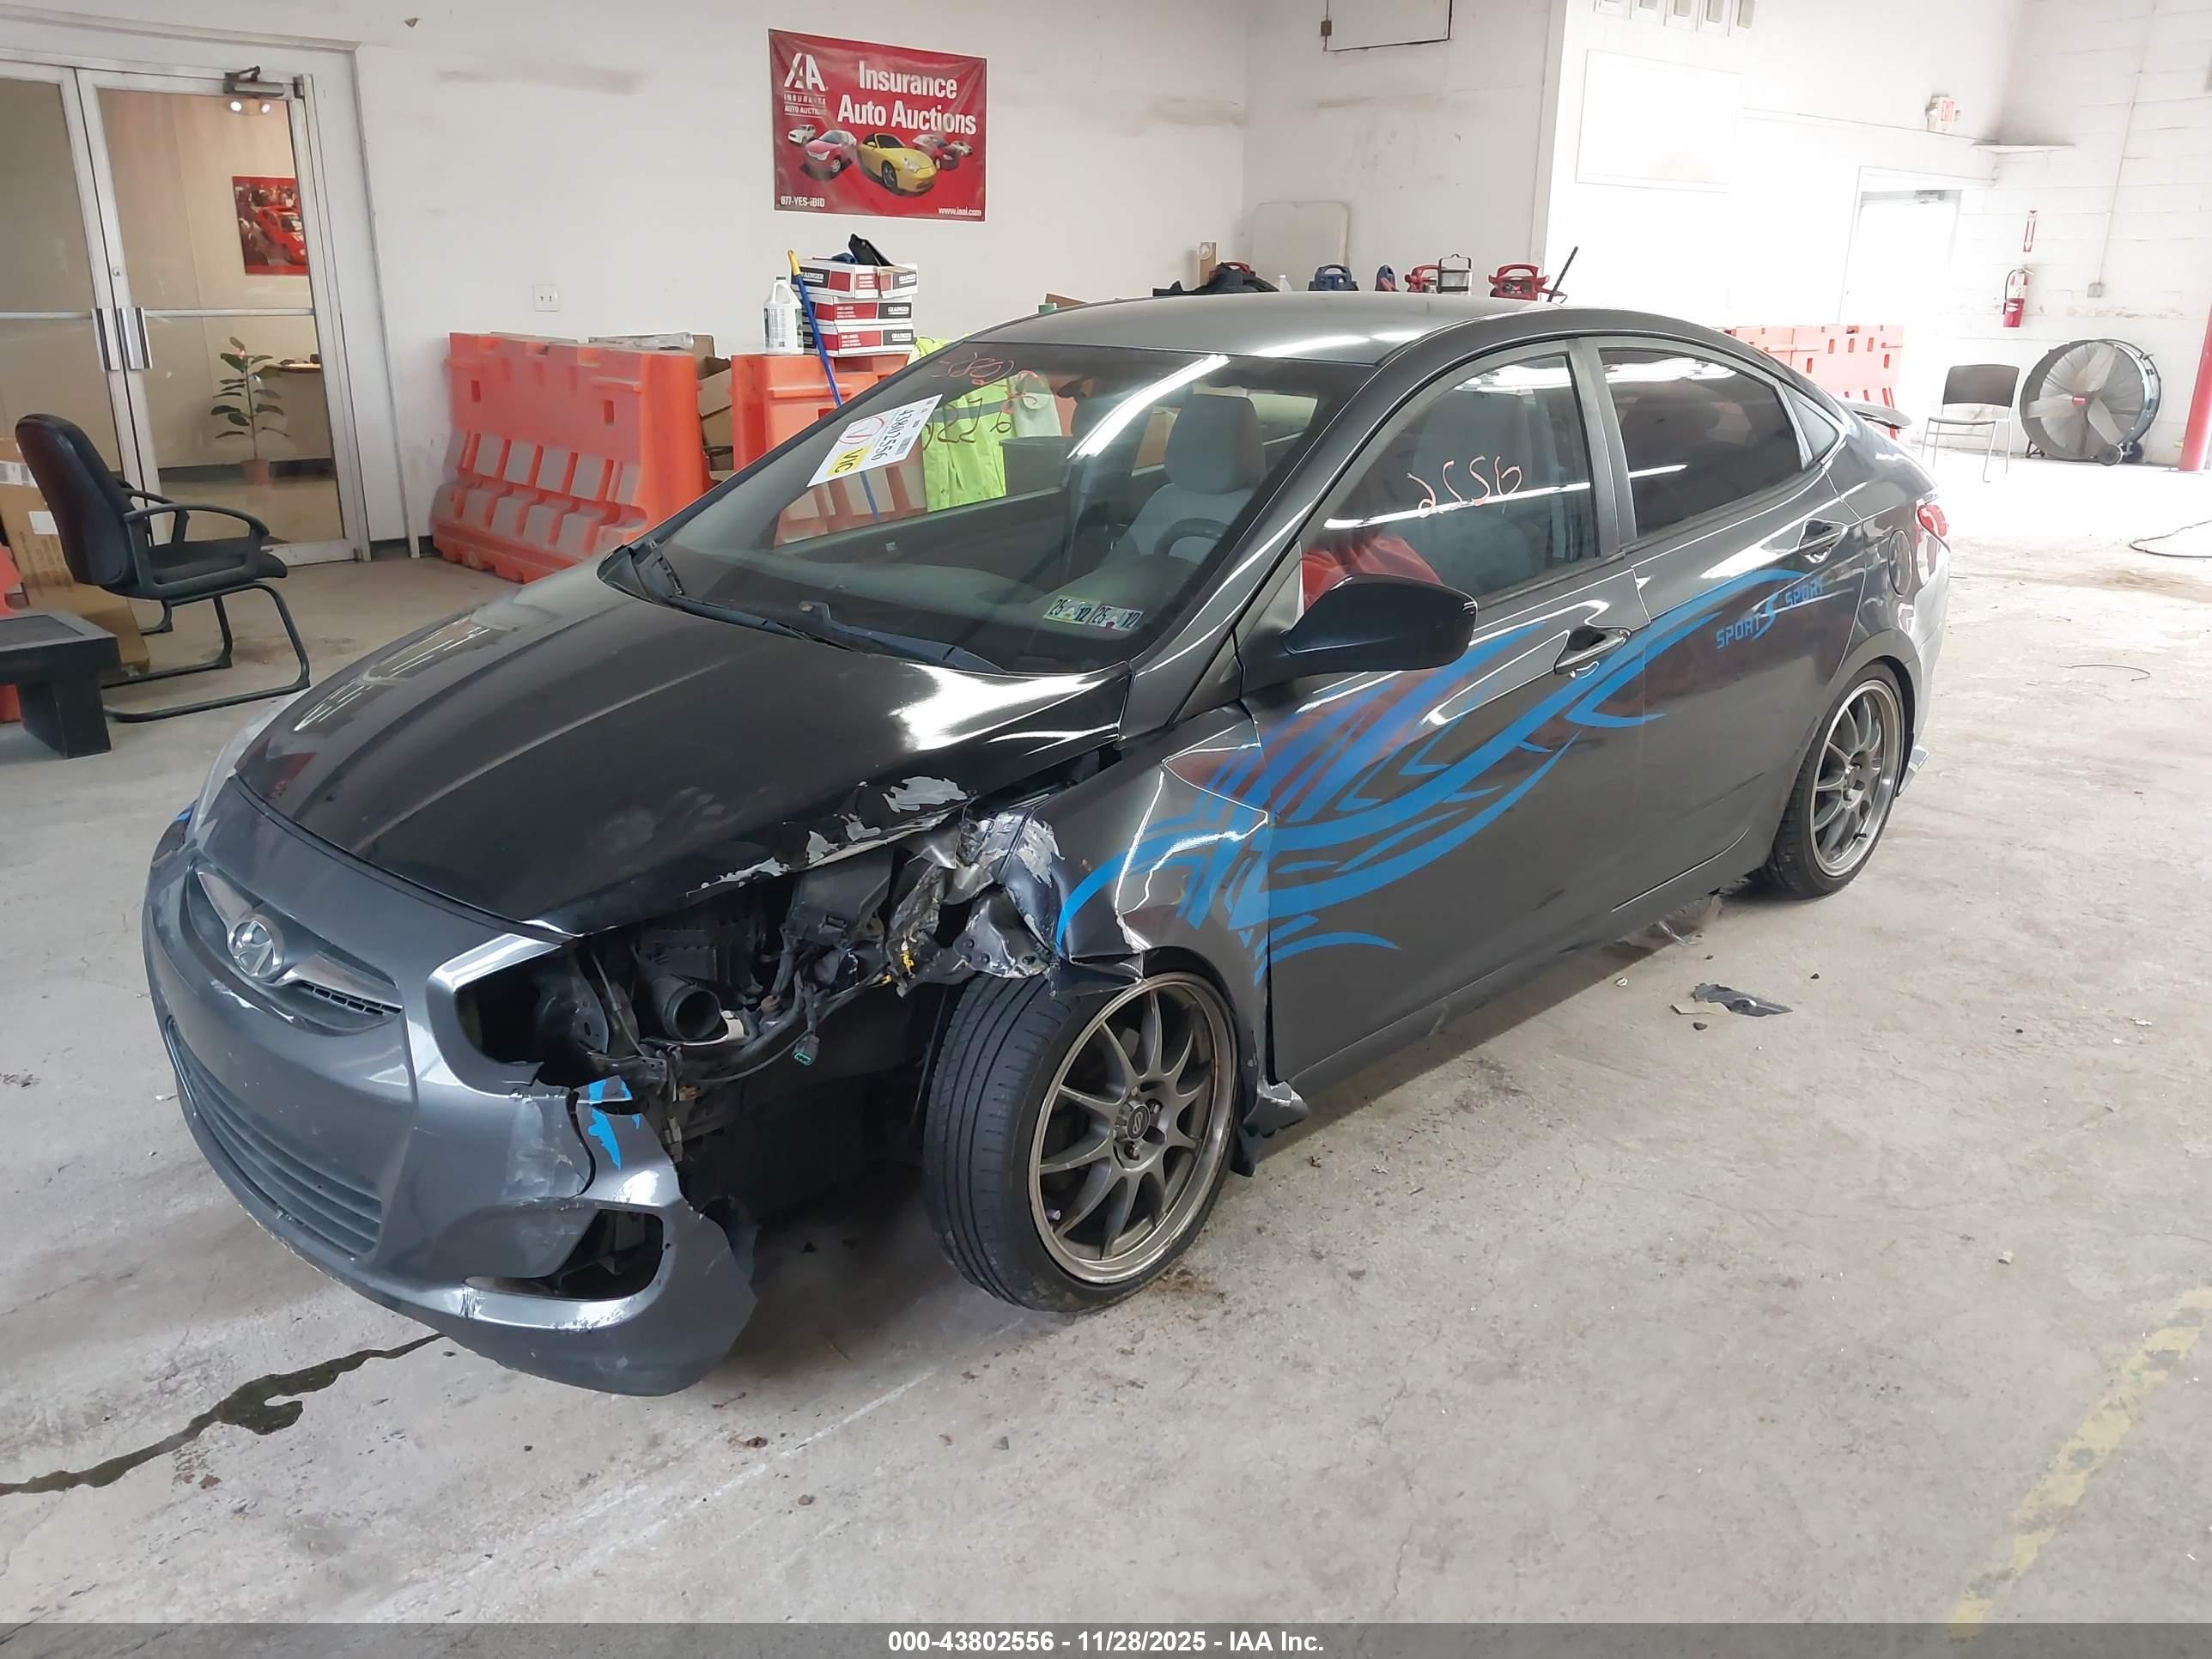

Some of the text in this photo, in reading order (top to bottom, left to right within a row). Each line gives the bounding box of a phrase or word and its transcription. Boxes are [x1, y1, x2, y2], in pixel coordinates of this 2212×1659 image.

[858, 60, 957, 99] Insurance
[837, 94, 977, 135] Auto Auctions
[871, 409, 916, 461] 43802556
[835, 447, 863, 473] VIC
[1784, 575, 1824, 607] SPORT
[1049, 599, 1092, 623] 25 12
[1091, 606, 1140, 629] 25 12
